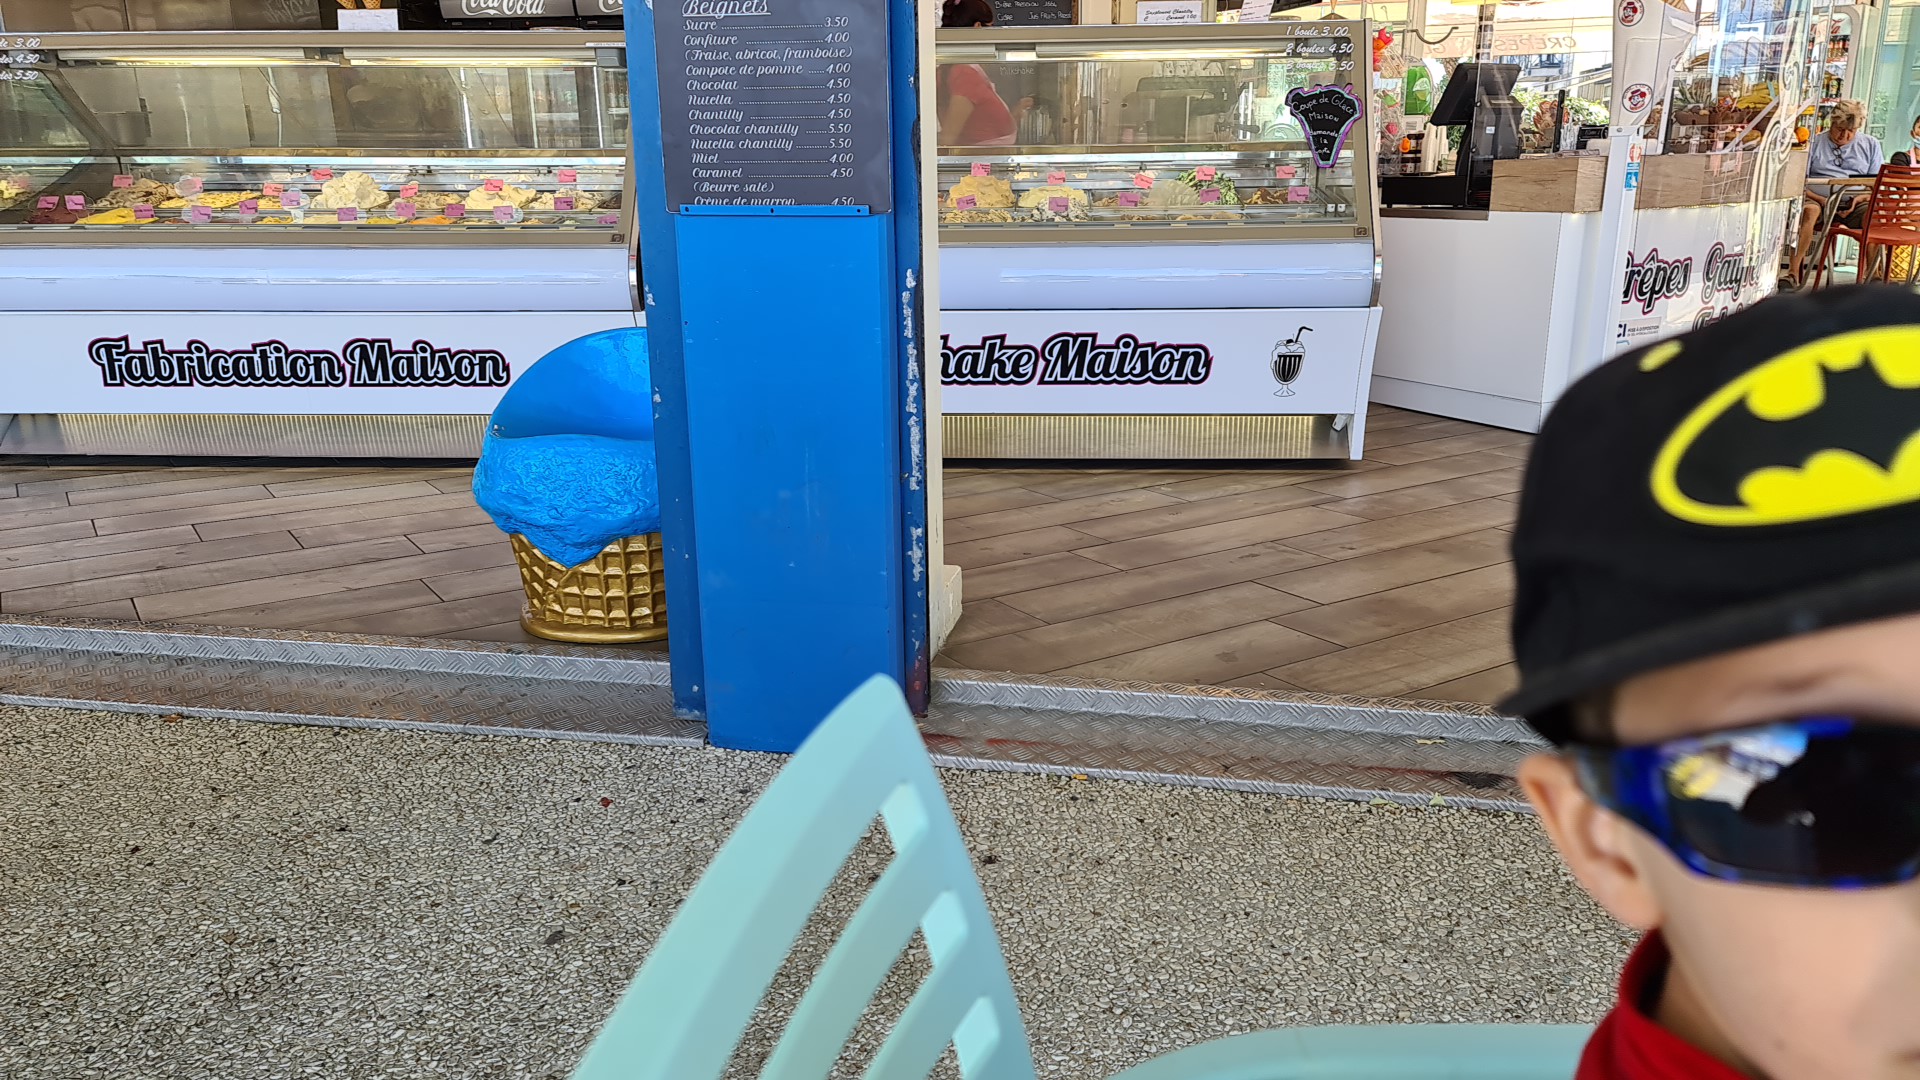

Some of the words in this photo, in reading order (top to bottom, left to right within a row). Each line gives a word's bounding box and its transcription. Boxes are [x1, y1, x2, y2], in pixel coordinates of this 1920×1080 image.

[682, 0, 768, 19] Beignets
[683, 19, 718, 31] Sucre
[824, 16, 849, 28] 3.50
[1294, 26, 1319, 36] boule
[1321, 26, 1349, 36] 3.00
[684, 34, 739, 48] Confiture
[824, 32, 850, 43] 4.00
[783, 47, 853, 62] framboise)
[1296, 43, 1325, 53] boules
[1328, 43, 1354, 53] 4.50
[685, 64, 736, 78] Compote
[739, 64, 755, 75] de
[756, 65, 803, 78] pomme
[826, 63, 851, 74] 4.00
[1328, 61, 1354, 71] 5.50
[686, 79, 739, 91] Chocolat
[826, 78, 851, 89] 4.50
[688, 94, 734, 105] Nutella
[826, 93, 851, 104] 4.50
[1292, 100, 1318, 113] Coupe
[1319, 94, 1329, 103] de
[688, 109, 744, 122] Chantilly
[827, 108, 852, 119] 4.50
[689, 123, 741, 135] Chocolat
[744, 124, 799, 137] chantilly
[828, 123, 852, 135] 5.50
[690, 138, 736, 150] Nutella
[738, 138, 794, 151] chantilly
[828, 138, 852, 149] 5.50
[691, 153, 720, 164] Miel
[829, 153, 854, 164] 4.00
[692, 167, 743, 178] Caramel
[830, 167, 854, 178] 4.50
[693, 181, 741, 192] (Beurre
[694, 195, 730, 206] Crème
[732, 196, 747, 206] de
[88, 335, 347, 387] Fabrication
[342, 337, 511, 387] Maison
[1037, 332, 1214, 386] Maison
